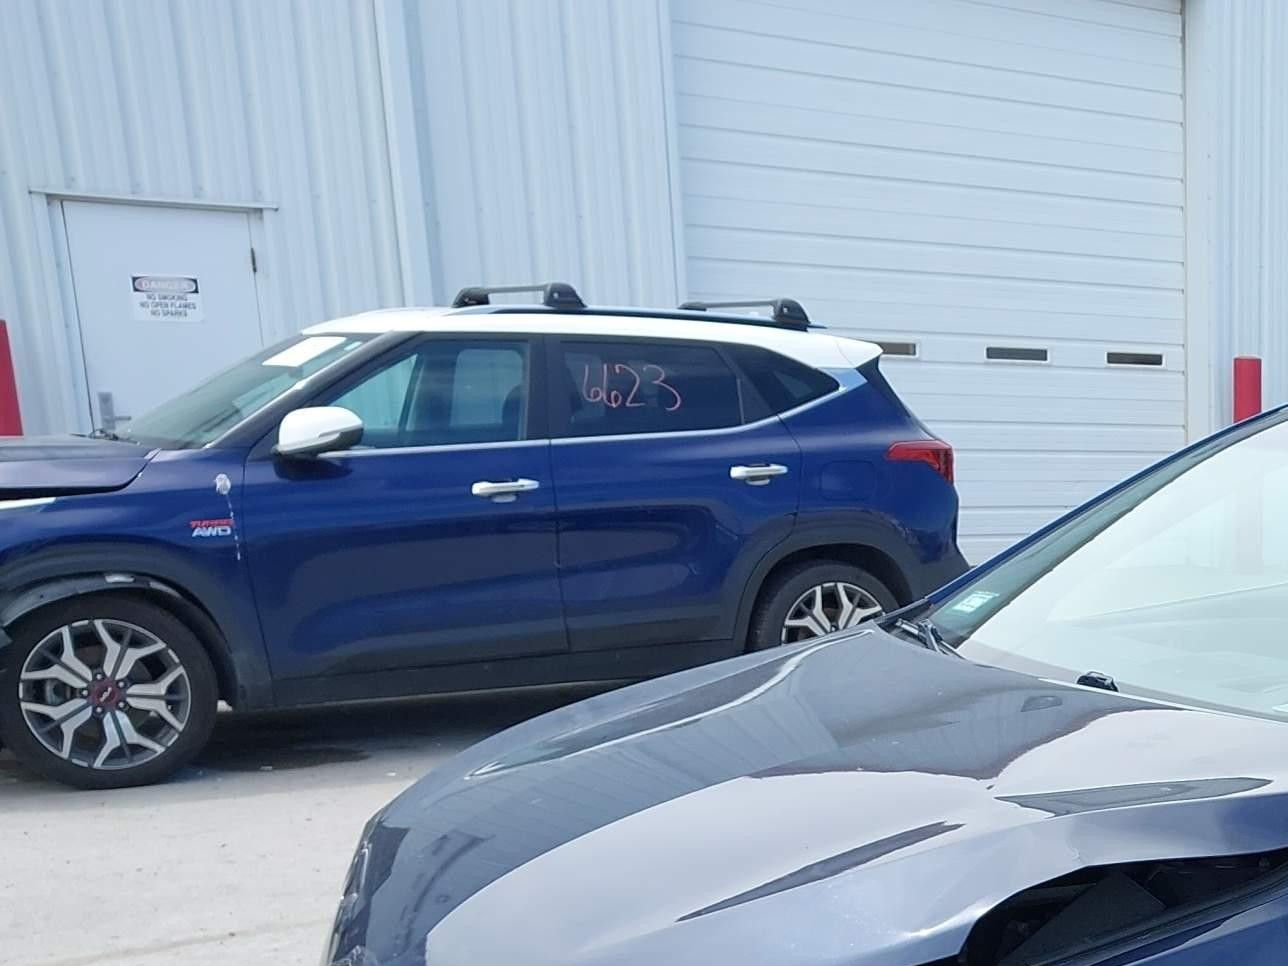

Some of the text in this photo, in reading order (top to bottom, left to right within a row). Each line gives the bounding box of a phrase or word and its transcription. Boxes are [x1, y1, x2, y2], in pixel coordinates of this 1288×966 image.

[141, 279, 189, 290] DANGER
[583, 363, 682, 411] 6623
[191, 526, 232, 537] AWD
